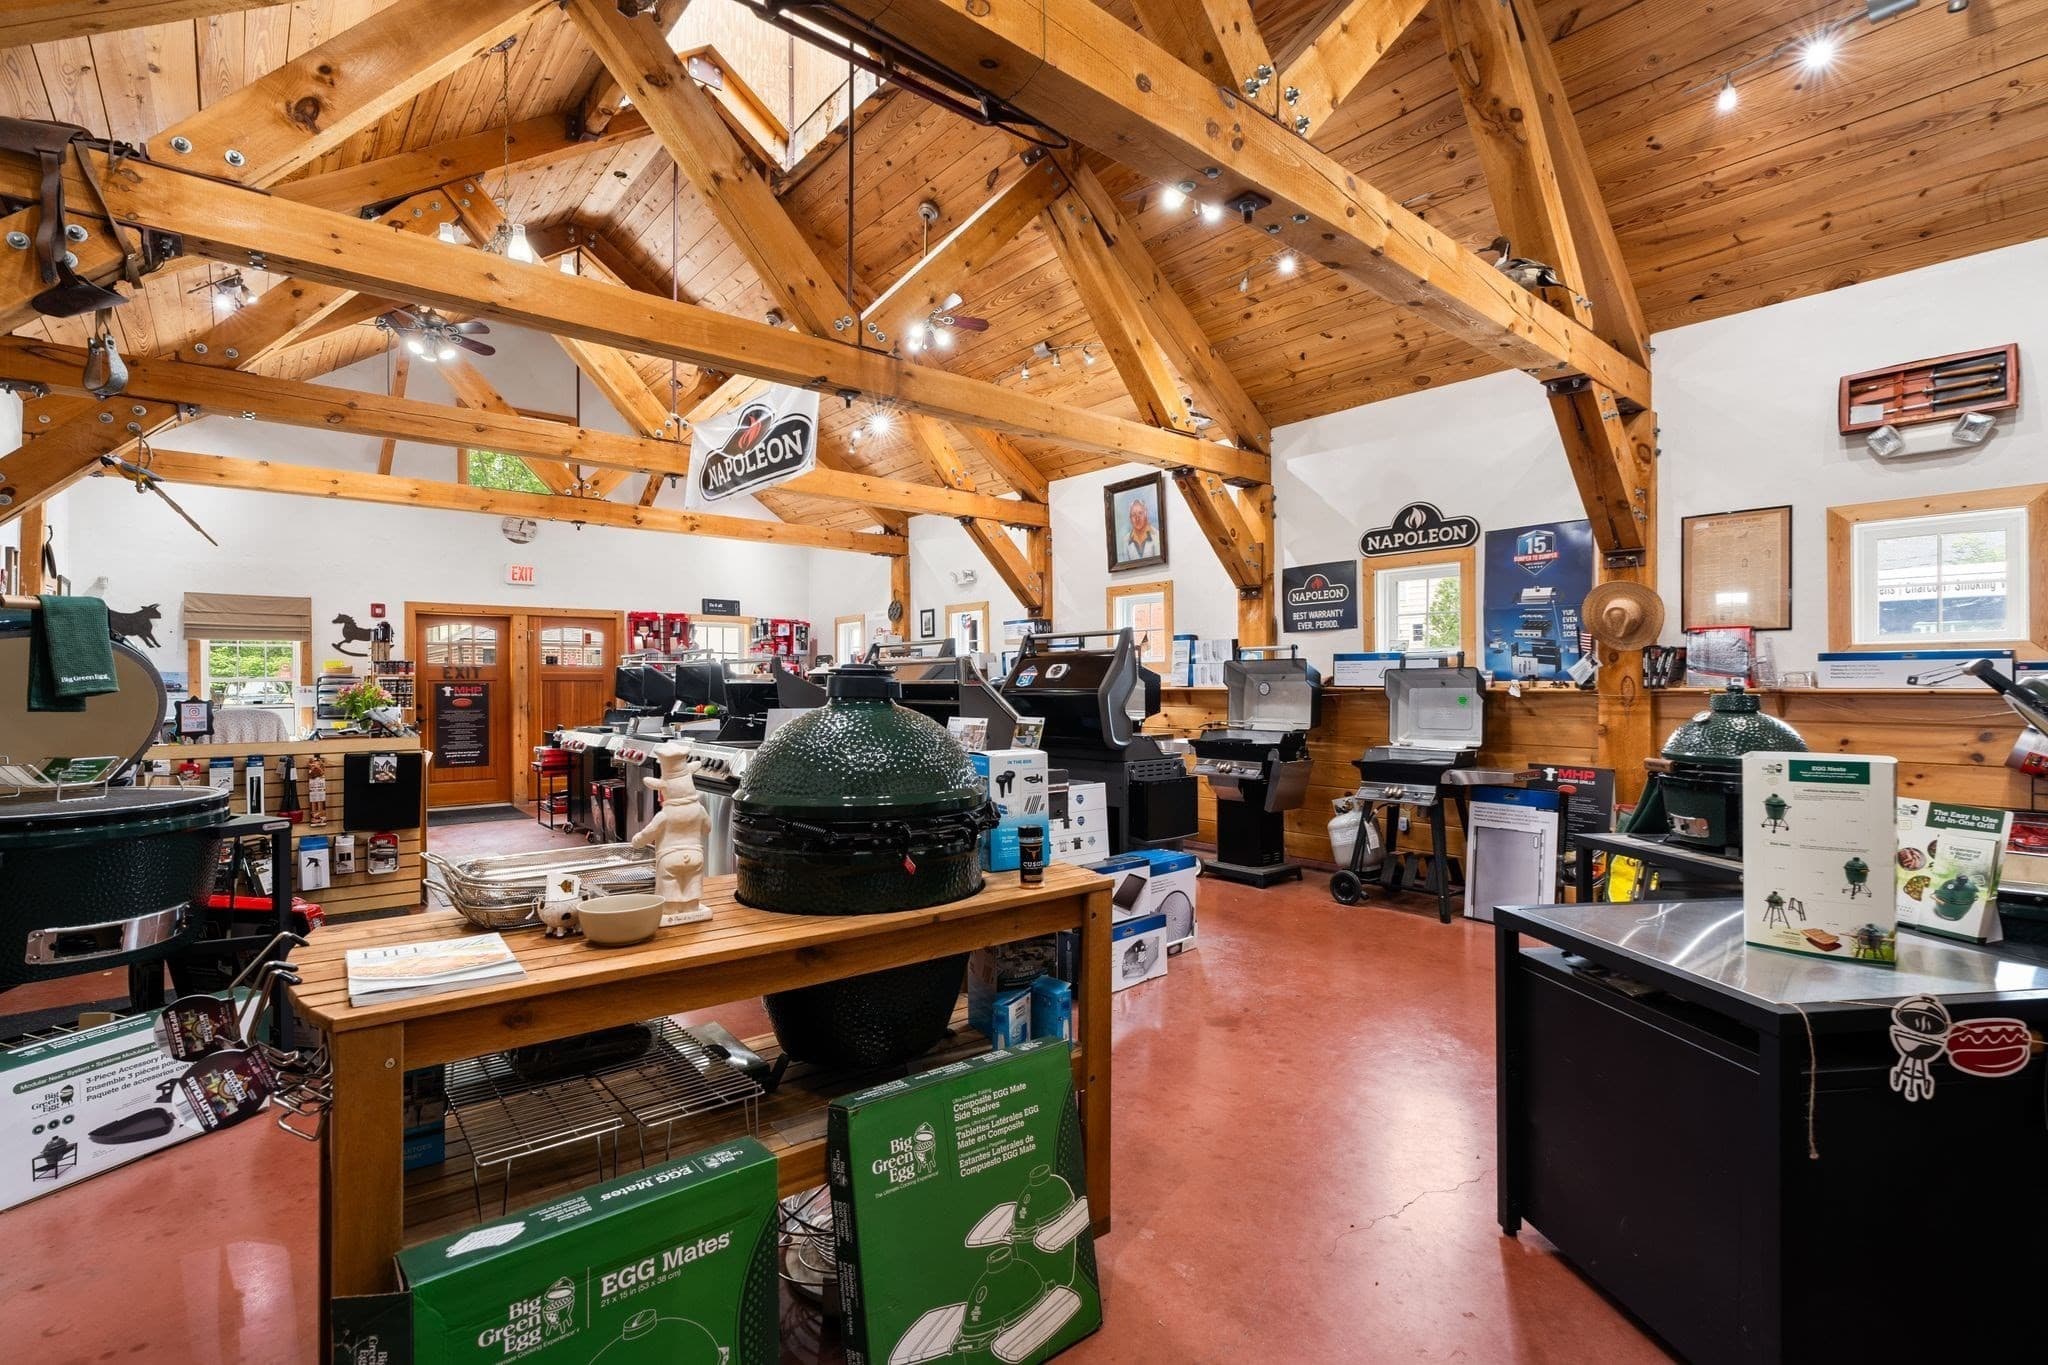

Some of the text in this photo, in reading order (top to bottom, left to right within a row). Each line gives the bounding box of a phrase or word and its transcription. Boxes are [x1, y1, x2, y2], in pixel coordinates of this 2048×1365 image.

[708, 430, 803, 490] NAPOLEON
[1367, 524, 1468, 551] NAPOLEON
[1526, 536, 1547, 554] 15
[511, 565, 534, 581] EXIT
[1292, 588, 1344, 602] NAPOLEON
[1292, 609, 1344, 621] BEST WARRANTY
[1297, 619, 1340, 631] EVER. PERIOD.
[1563, 630, 1577, 638] SCRE
[443, 666, 482, 680] EXIT
[454, 686, 483, 694] MHP
[1558, 768, 1596, 780] MHP
[1933, 809, 1949, 817] The
[1950, 811, 1971, 821] Easy
[1982, 816, 1999, 824] Use
[1976, 821, 1996, 830] Grill
[168, 1010, 180, 1034] SUPER
[86, 1070, 116, 1084] 3-Piece
[119, 1056, 159, 1074] Accessory
[86, 1076, 126, 1093] Ensemble
[161, 1060, 178, 1069] pour
[86, 1064, 189, 1102] Paquete de accesorios con
[187, 1076, 205, 1103] SUPER
[32, 1098, 59, 1110] Green
[45, 1091, 59, 1101] Big
[953, 1083, 1027, 1113] Composite EGG Mate
[954, 1101, 1000, 1122] Side Shelves
[956, 1104, 1039, 1140] Tablettes Latérales EGG
[890, 1136, 913, 1155] Big
[957, 1138, 976, 1150] Mate
[977, 1133, 987, 1143] en
[959, 1134, 1034, 1168] Estantes Laterales de
[872, 1151, 914, 1175] Green
[960, 1143, 1036, 1178] Compuesto EGG Mate
[658, 1165, 694, 1184] EGG
[889, 1164, 916, 1183] Egg
[600, 1179, 656, 1202] Mates
[601, 1232, 730, 1297] EGG Mates
[600, 1299, 610, 1308] 21
[619, 1290, 629, 1300] 15
[629, 1288, 637, 1296] in
[638, 1283, 650, 1294] (53
[667, 1269, 682, 1281] cm)
[509, 1295, 542, 1320] Big
[478, 1313, 541, 1348] Green
[504, 1326, 542, 1354] Egg
[517, 1341, 543, 1359] Cooking
